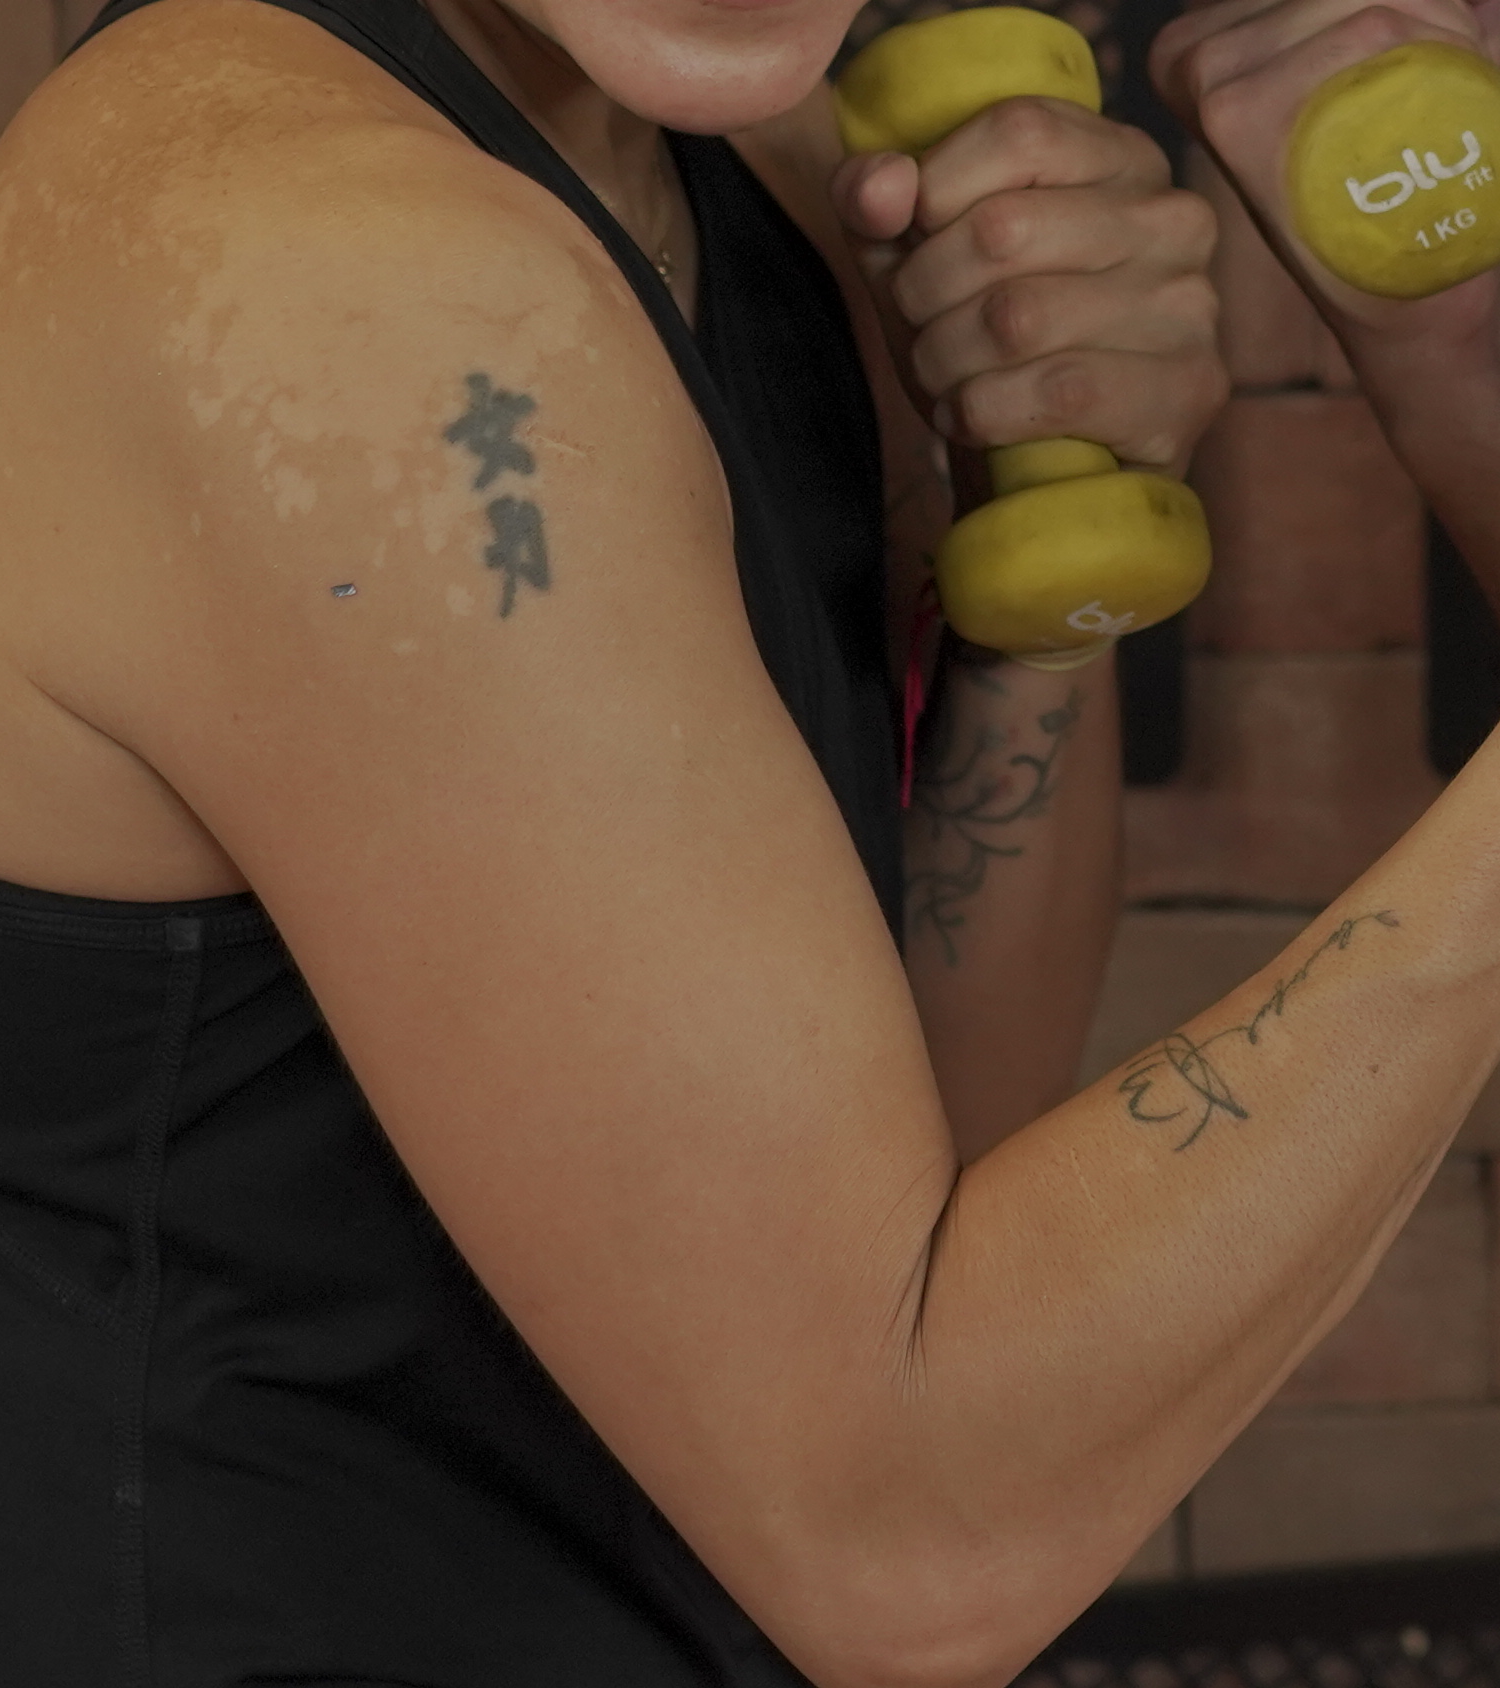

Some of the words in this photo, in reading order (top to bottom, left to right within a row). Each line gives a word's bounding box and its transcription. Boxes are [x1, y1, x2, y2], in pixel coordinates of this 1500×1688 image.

[1344, 129, 1482, 214] blu
[1462, 164, 1495, 192] fit
[1414, 229, 1431, 250] 1
[1434, 207, 1477, 242] KG
